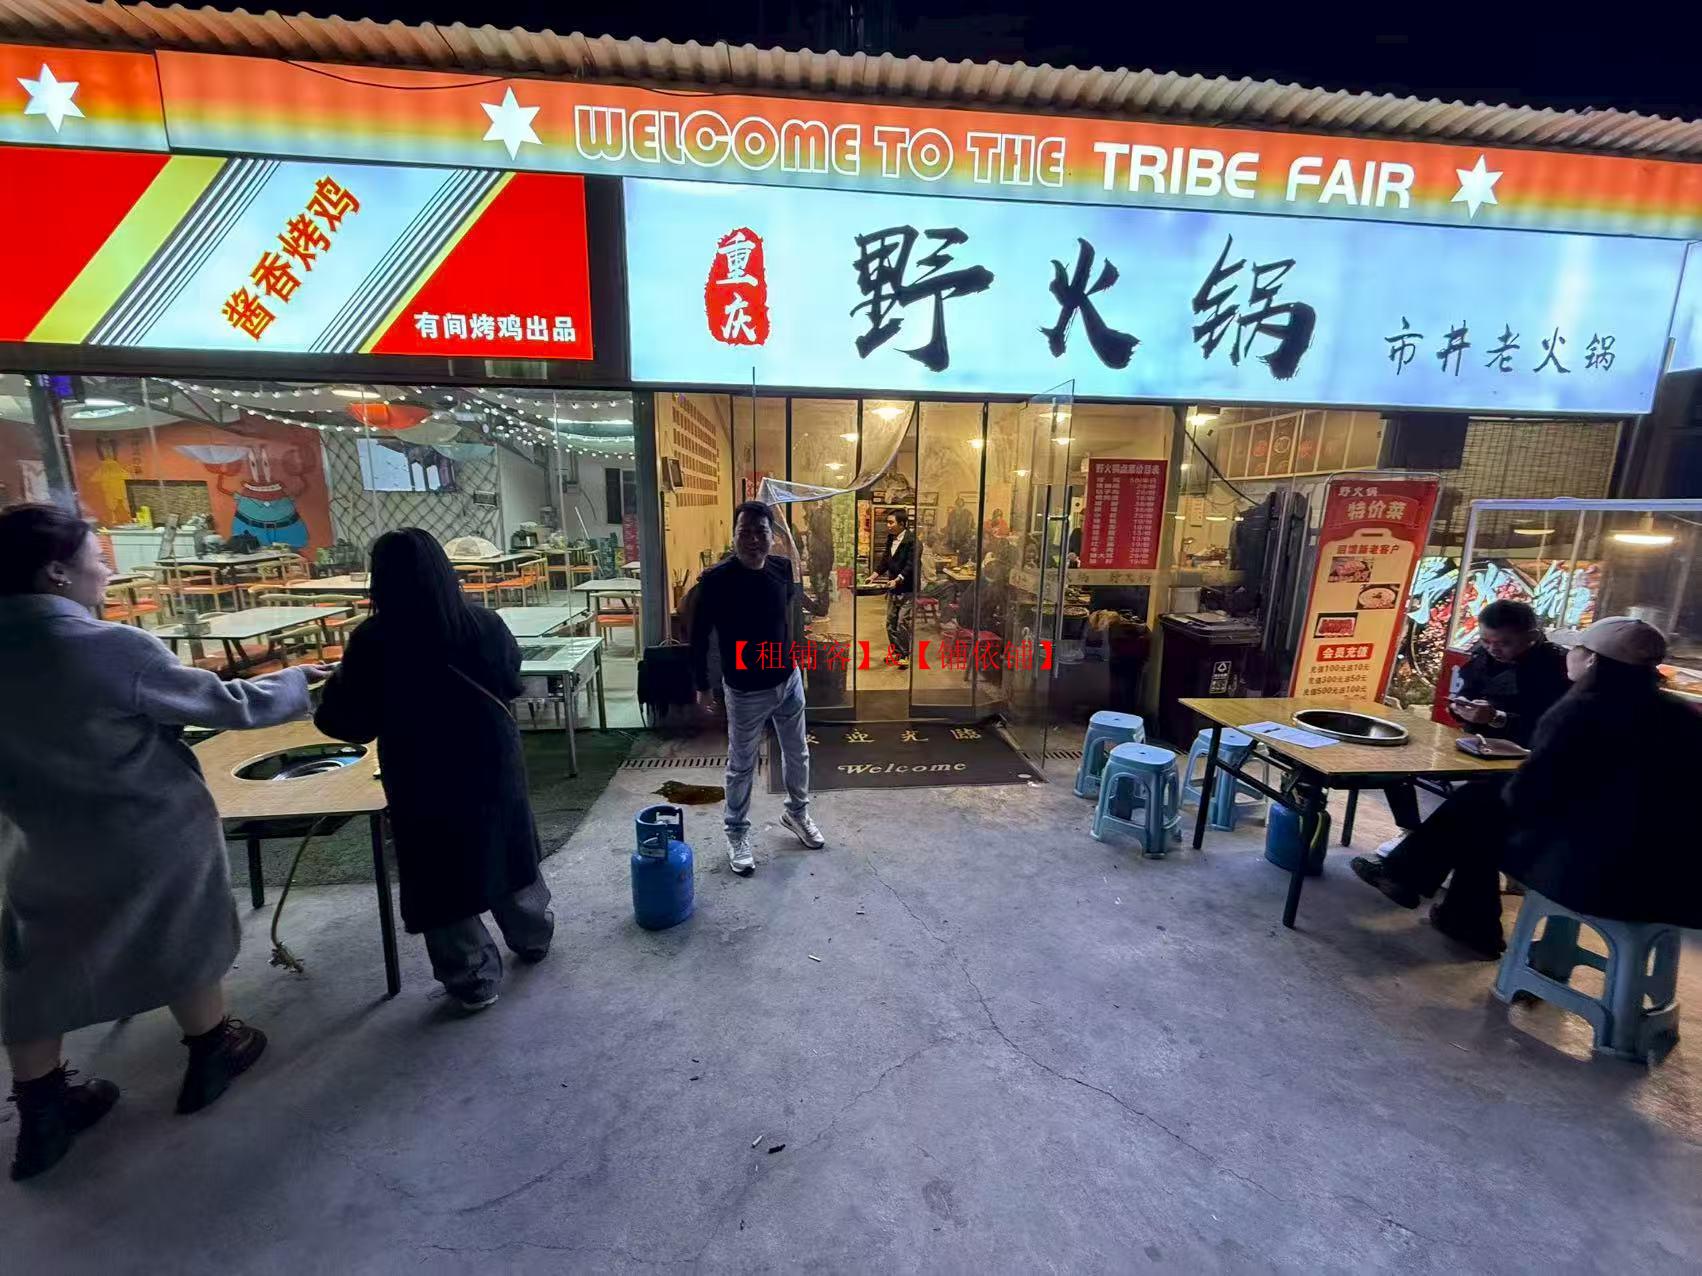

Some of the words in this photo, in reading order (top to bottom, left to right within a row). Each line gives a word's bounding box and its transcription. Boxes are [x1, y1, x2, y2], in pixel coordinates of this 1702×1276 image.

[574, 104, 861, 176] WELCOME
[874, 125, 954, 181] TO
[966, 131, 1066, 187] THE
[1093, 142, 1260, 199] TRIBE
[1285, 156, 1416, 208] FAIR
[220, 175, 362, 341] 酱香烤鸡
[715, 231, 760, 343] 重庆
[413, 311, 577, 343] 有间烤鸡出品
[850, 224, 1318, 381] 野火锅
[1384, 315, 1617, 376] 市井老火锅
[1347, 500, 1407, 520] 特价菜
[1322, 646, 1369, 659] 会员充值
[837, 762, 967, 775] Welcome
